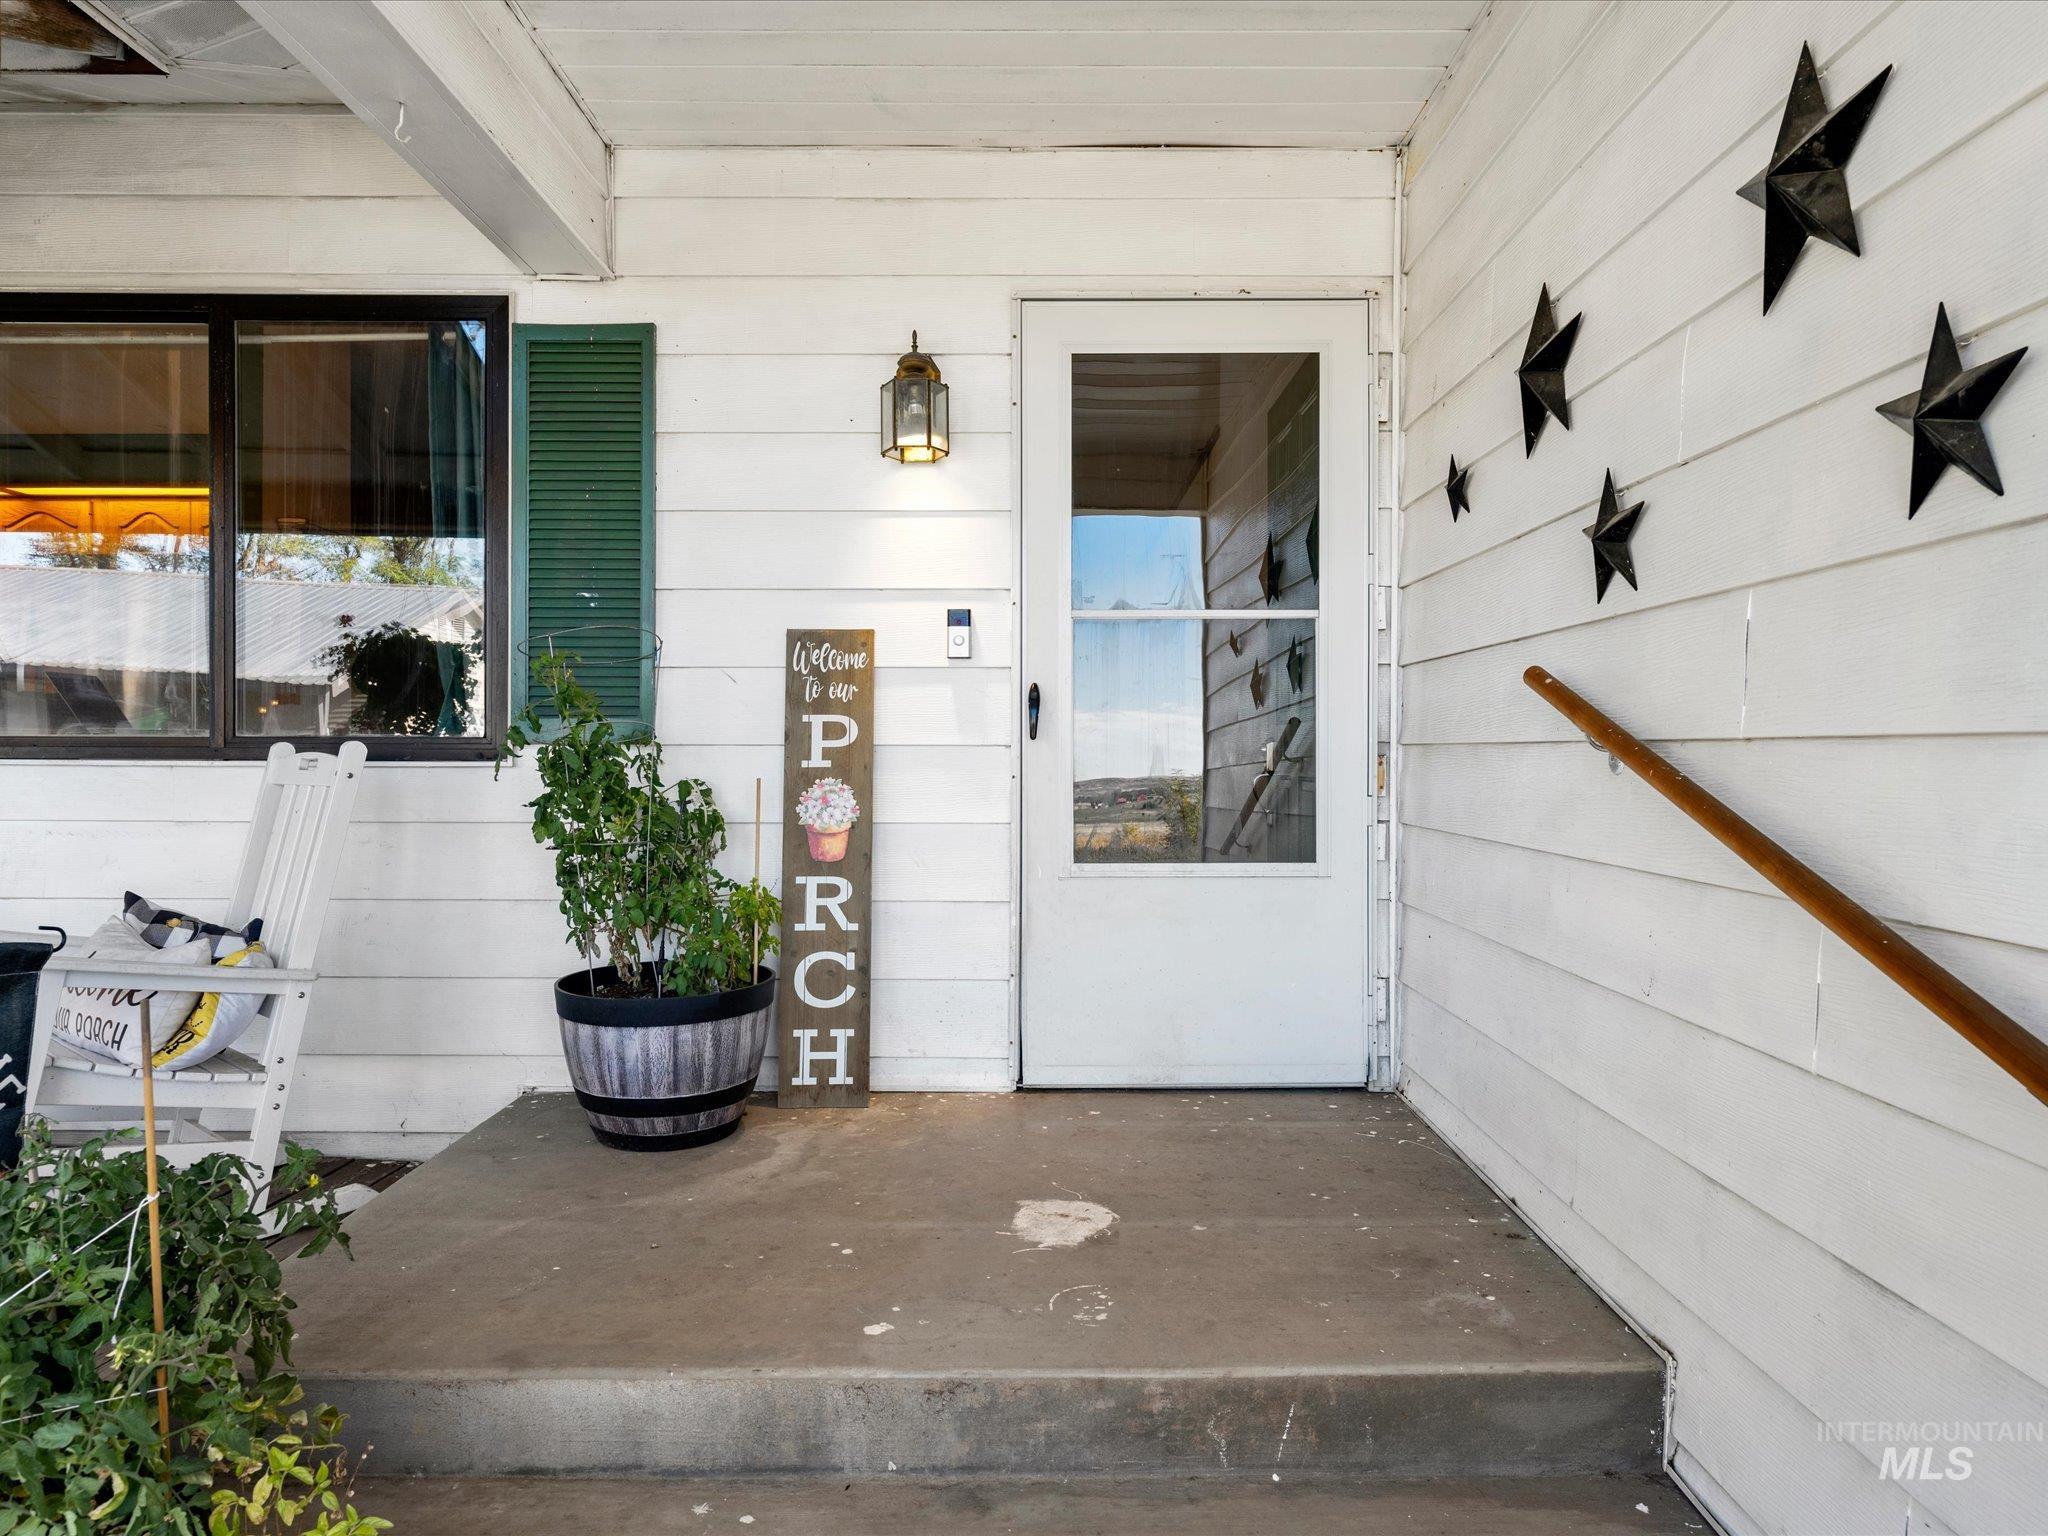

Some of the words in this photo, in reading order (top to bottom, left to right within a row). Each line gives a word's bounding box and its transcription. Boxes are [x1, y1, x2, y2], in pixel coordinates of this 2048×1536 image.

[793, 641, 869, 674] Welcome
[803, 676, 824, 702] to
[829, 682, 858, 702] our
[76, 1013, 128, 1051] PORCH
